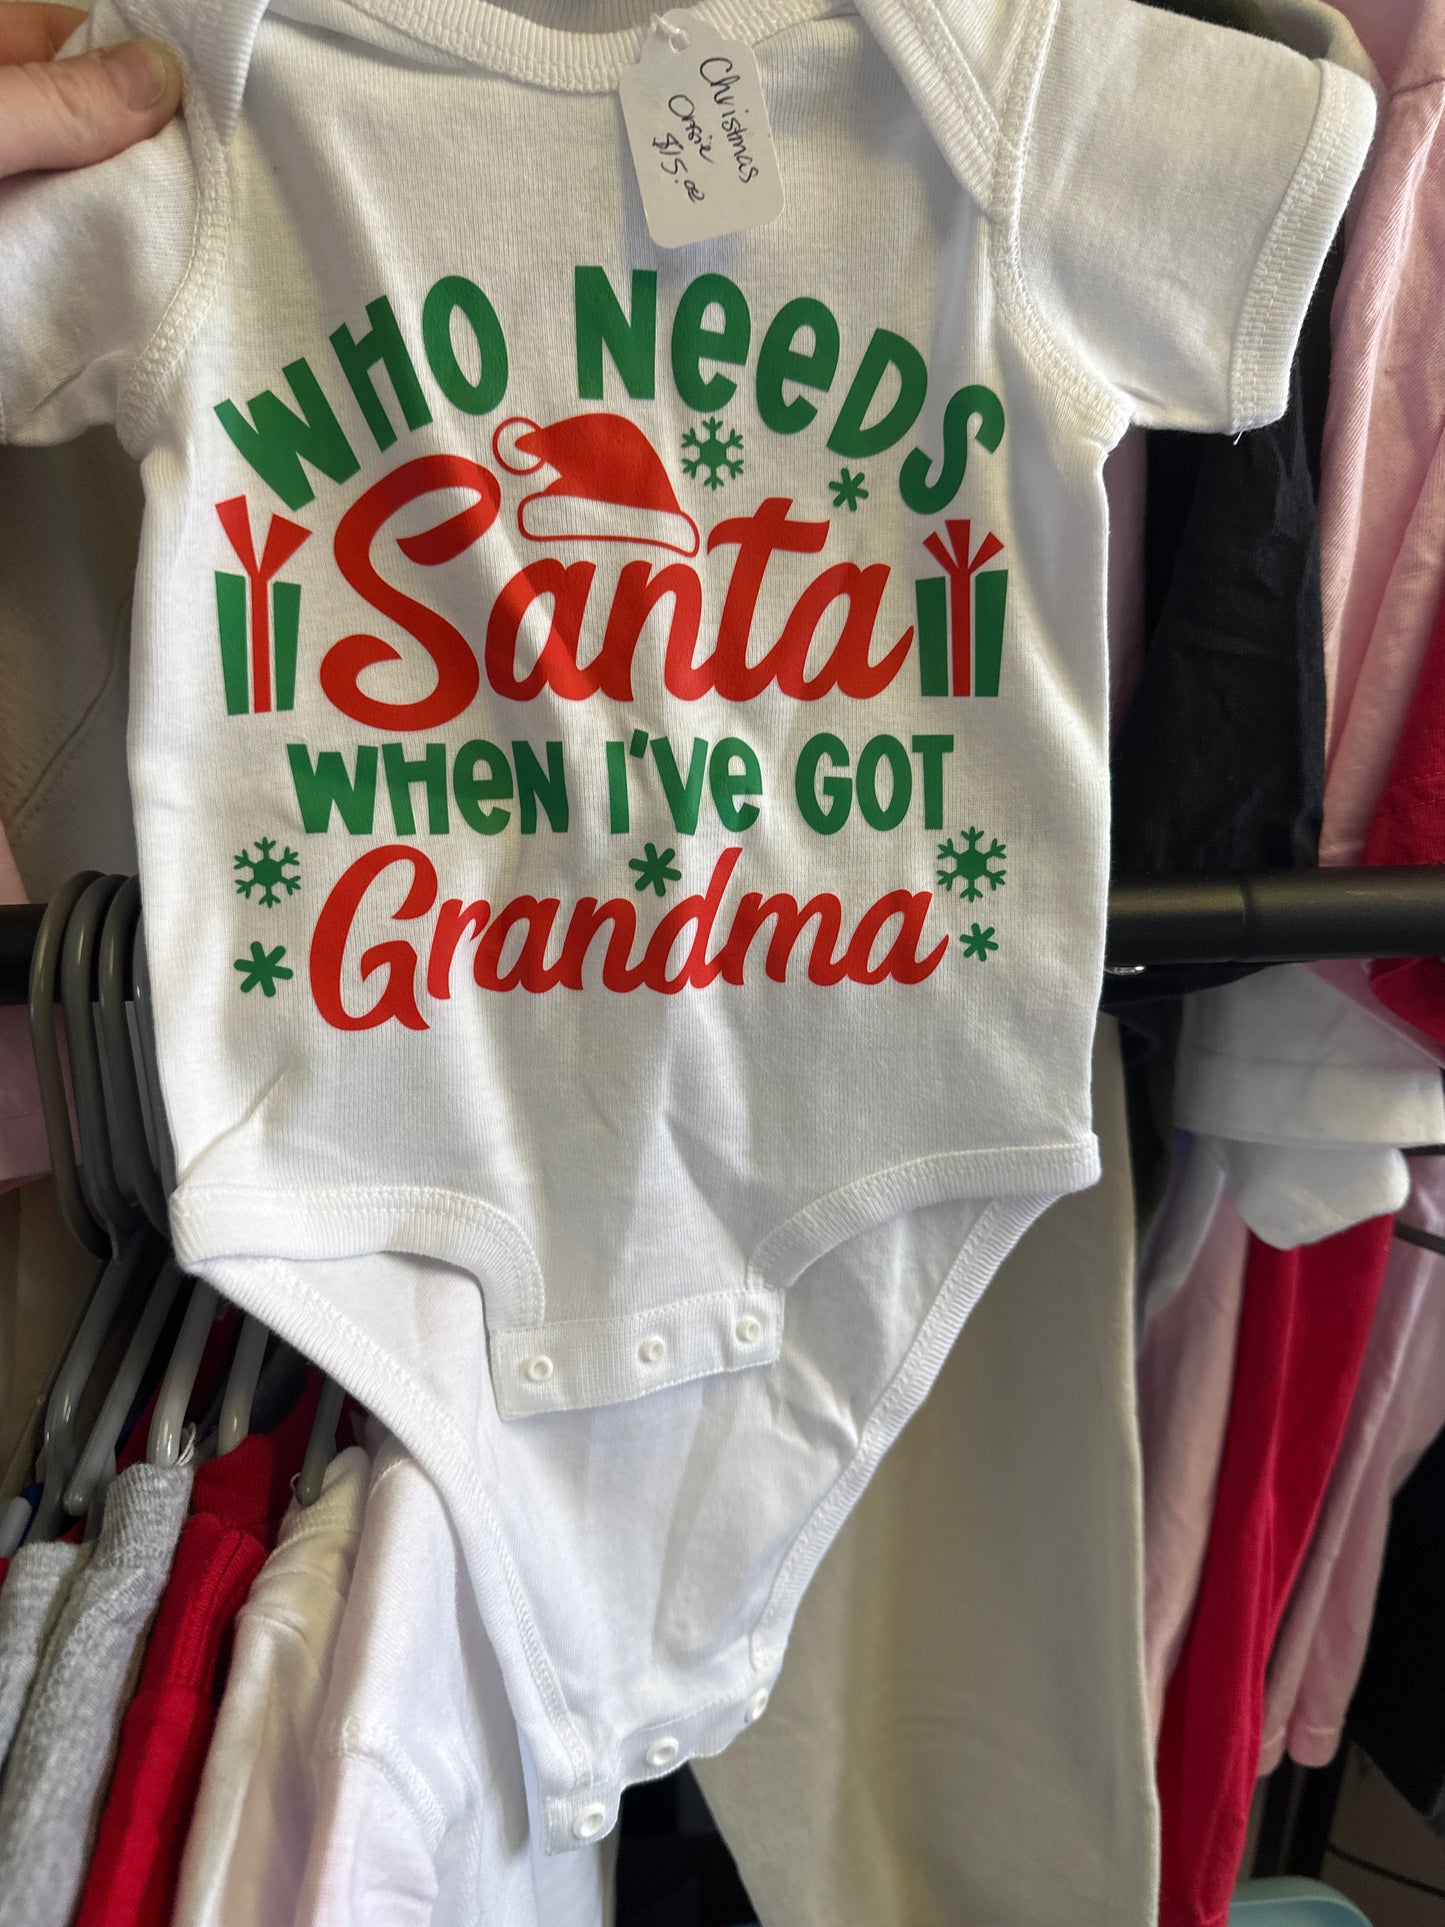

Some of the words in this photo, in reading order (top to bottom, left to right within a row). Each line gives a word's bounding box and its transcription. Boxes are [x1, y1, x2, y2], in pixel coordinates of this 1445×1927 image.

[700, 57, 759, 184] Christmas
[215, 277, 509, 512] WHO
[320, 454, 915, 732] Santa
[795, 732, 954, 834] GOT
[309, 844, 949, 1031] Grandma
